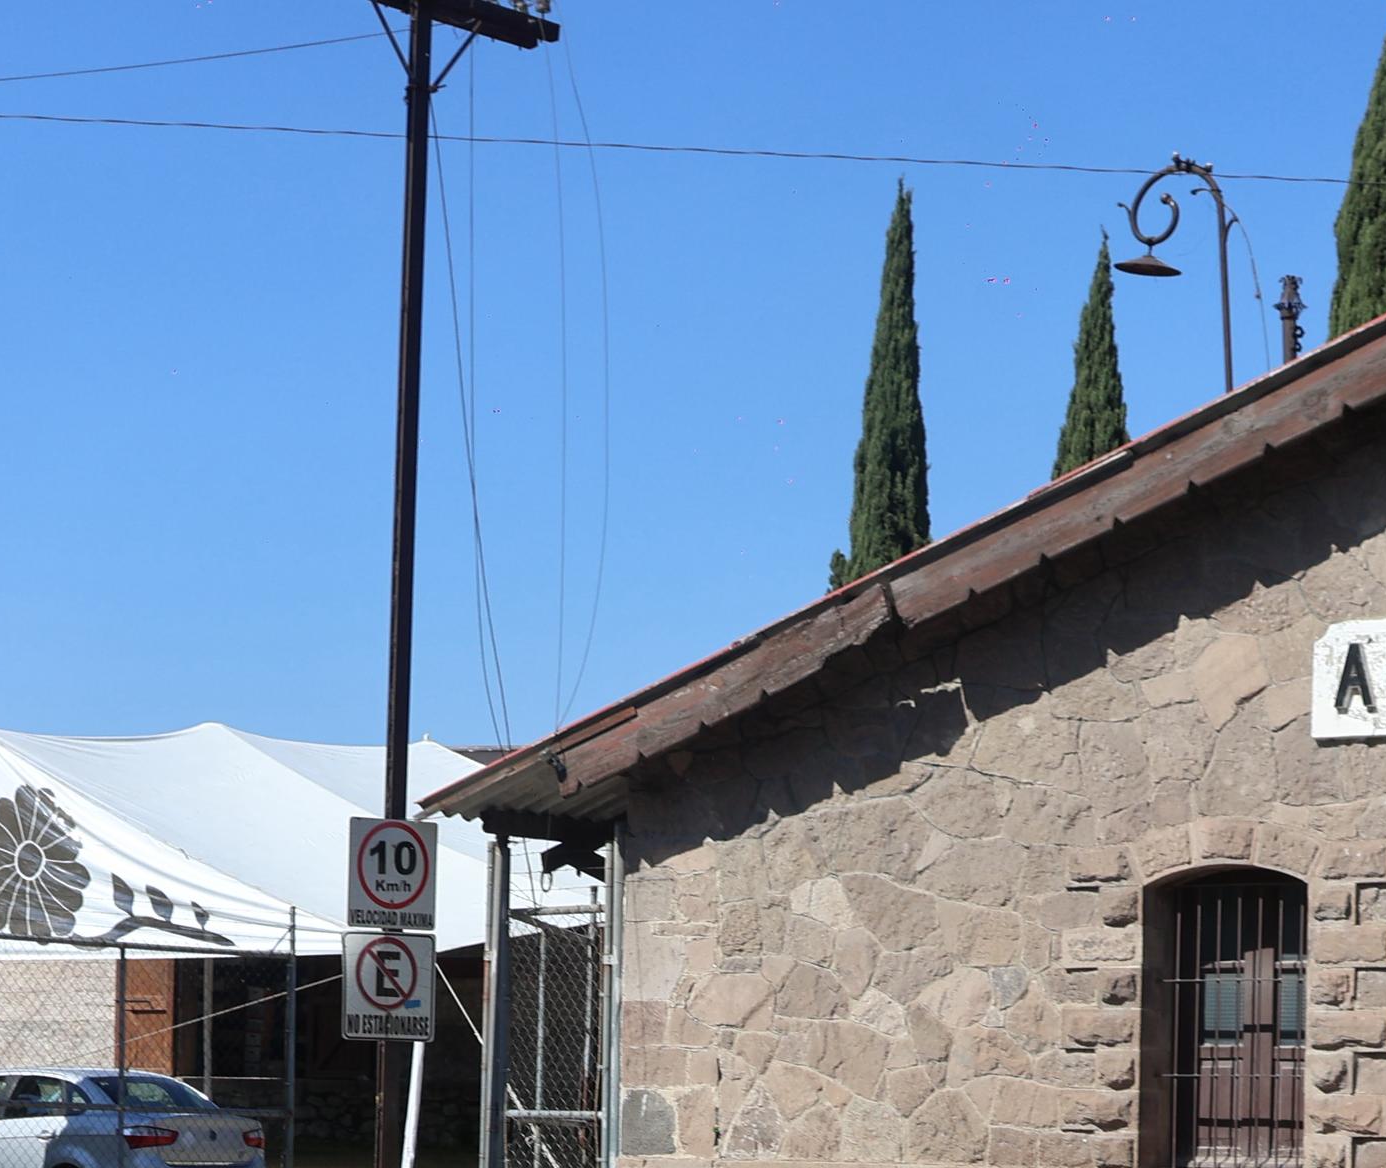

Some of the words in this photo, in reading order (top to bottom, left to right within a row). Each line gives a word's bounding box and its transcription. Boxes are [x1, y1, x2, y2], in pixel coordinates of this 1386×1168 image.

[370, 840, 417, 876] 10
[375, 879, 412, 892] Km/h
[349, 908, 397, 926] VELOCIDAD
[376, 951, 401, 998] E
[347, 1013, 360, 1034] NO
